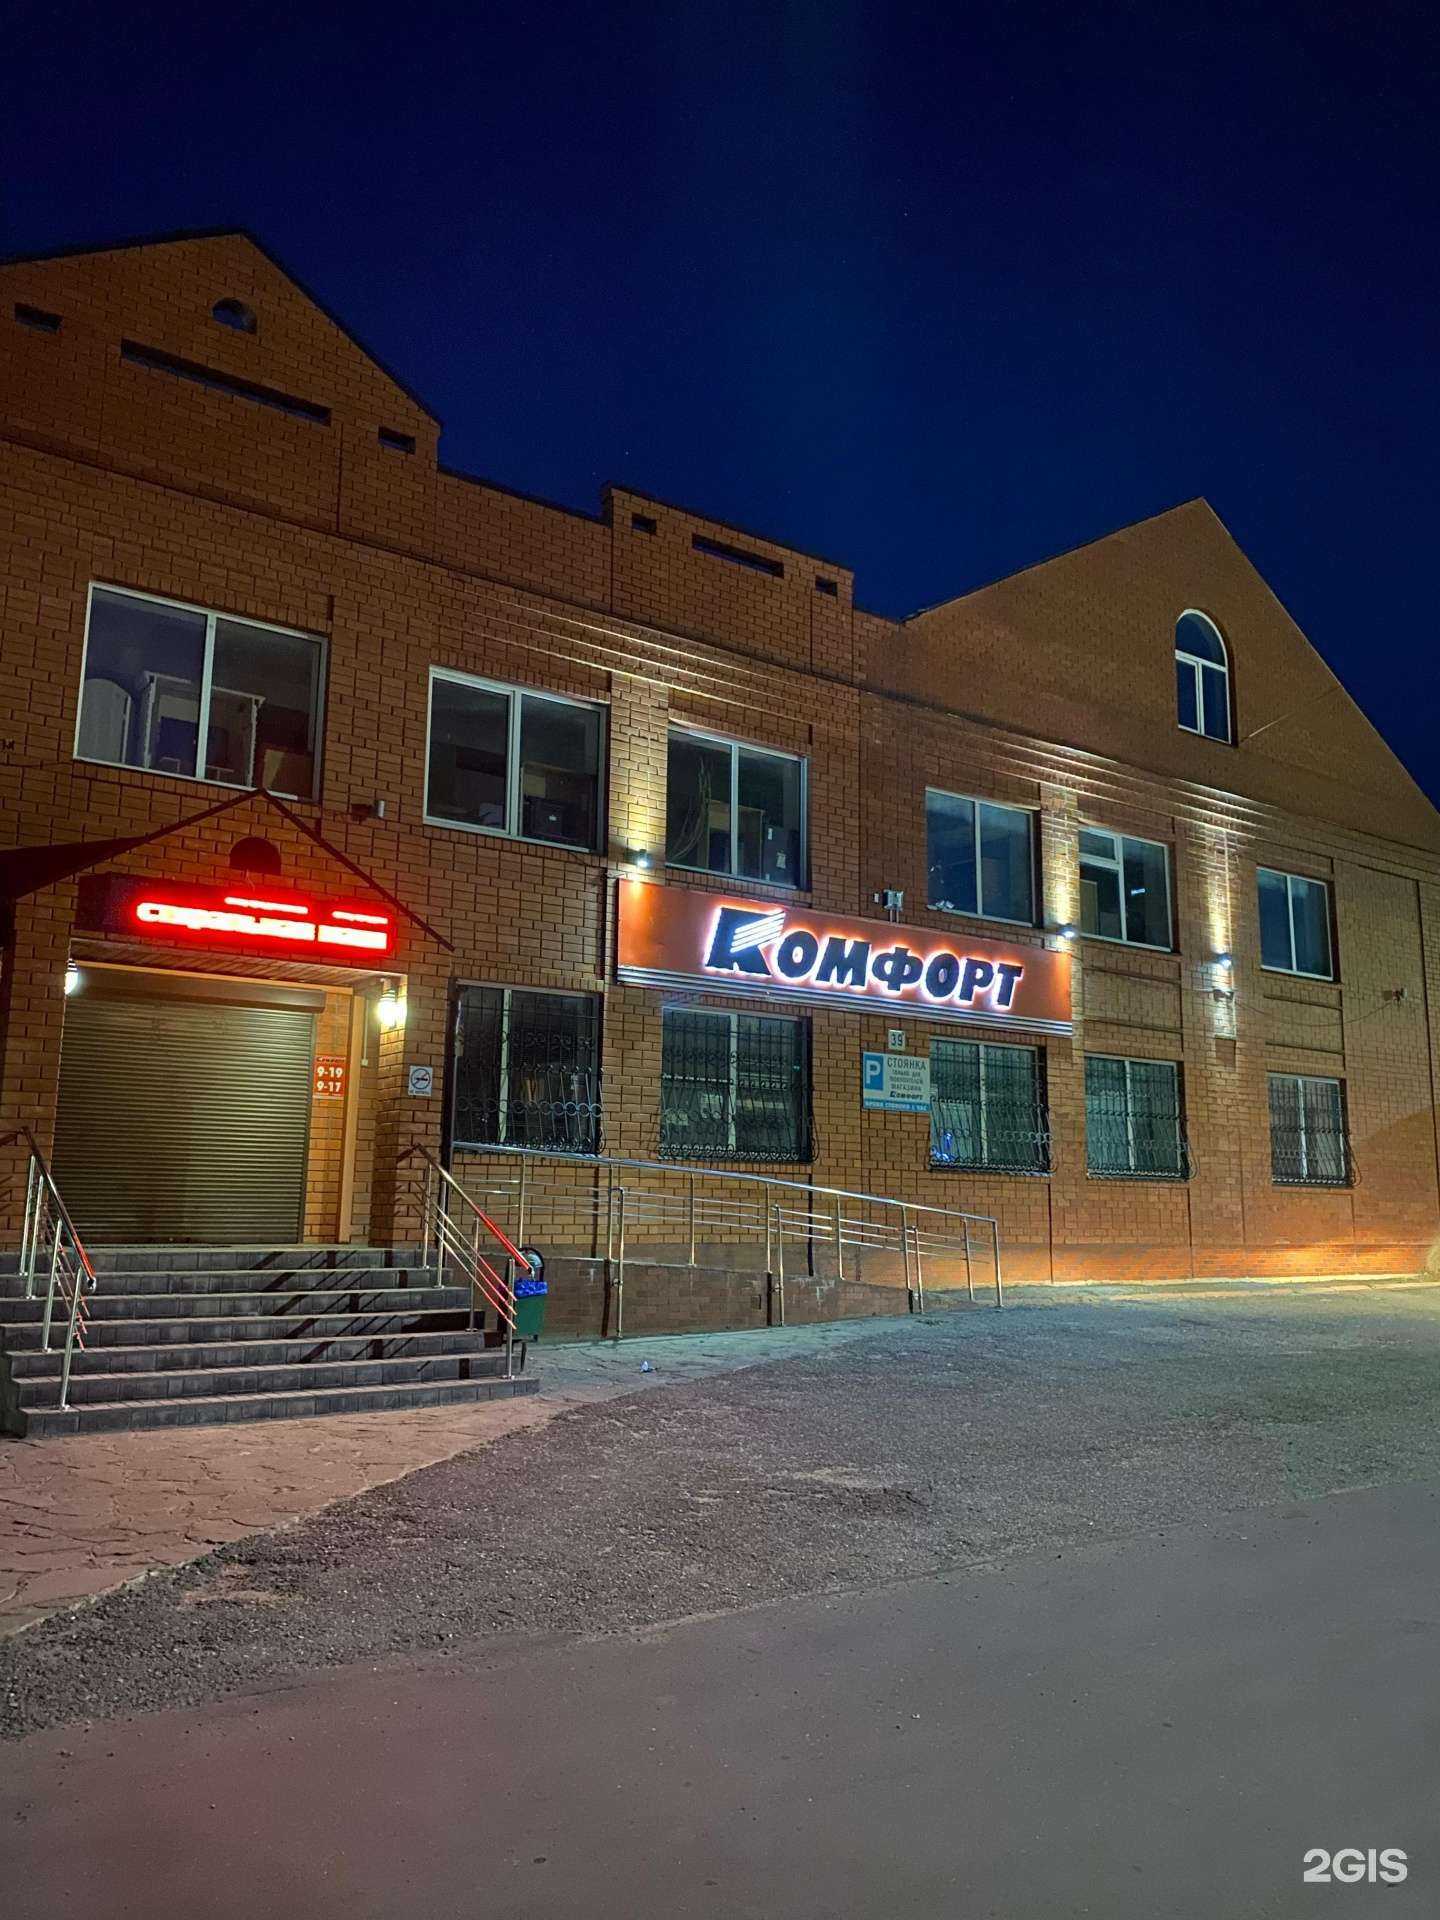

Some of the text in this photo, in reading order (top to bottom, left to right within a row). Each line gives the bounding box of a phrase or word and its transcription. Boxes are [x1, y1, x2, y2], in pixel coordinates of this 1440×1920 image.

[890, 1033, 903, 1047] 39
[887, 1057, 926, 1071] СТОЯНКА
[316, 1066, 343, 1079] 9-19
[316, 1081, 342, 1093] 9-17
